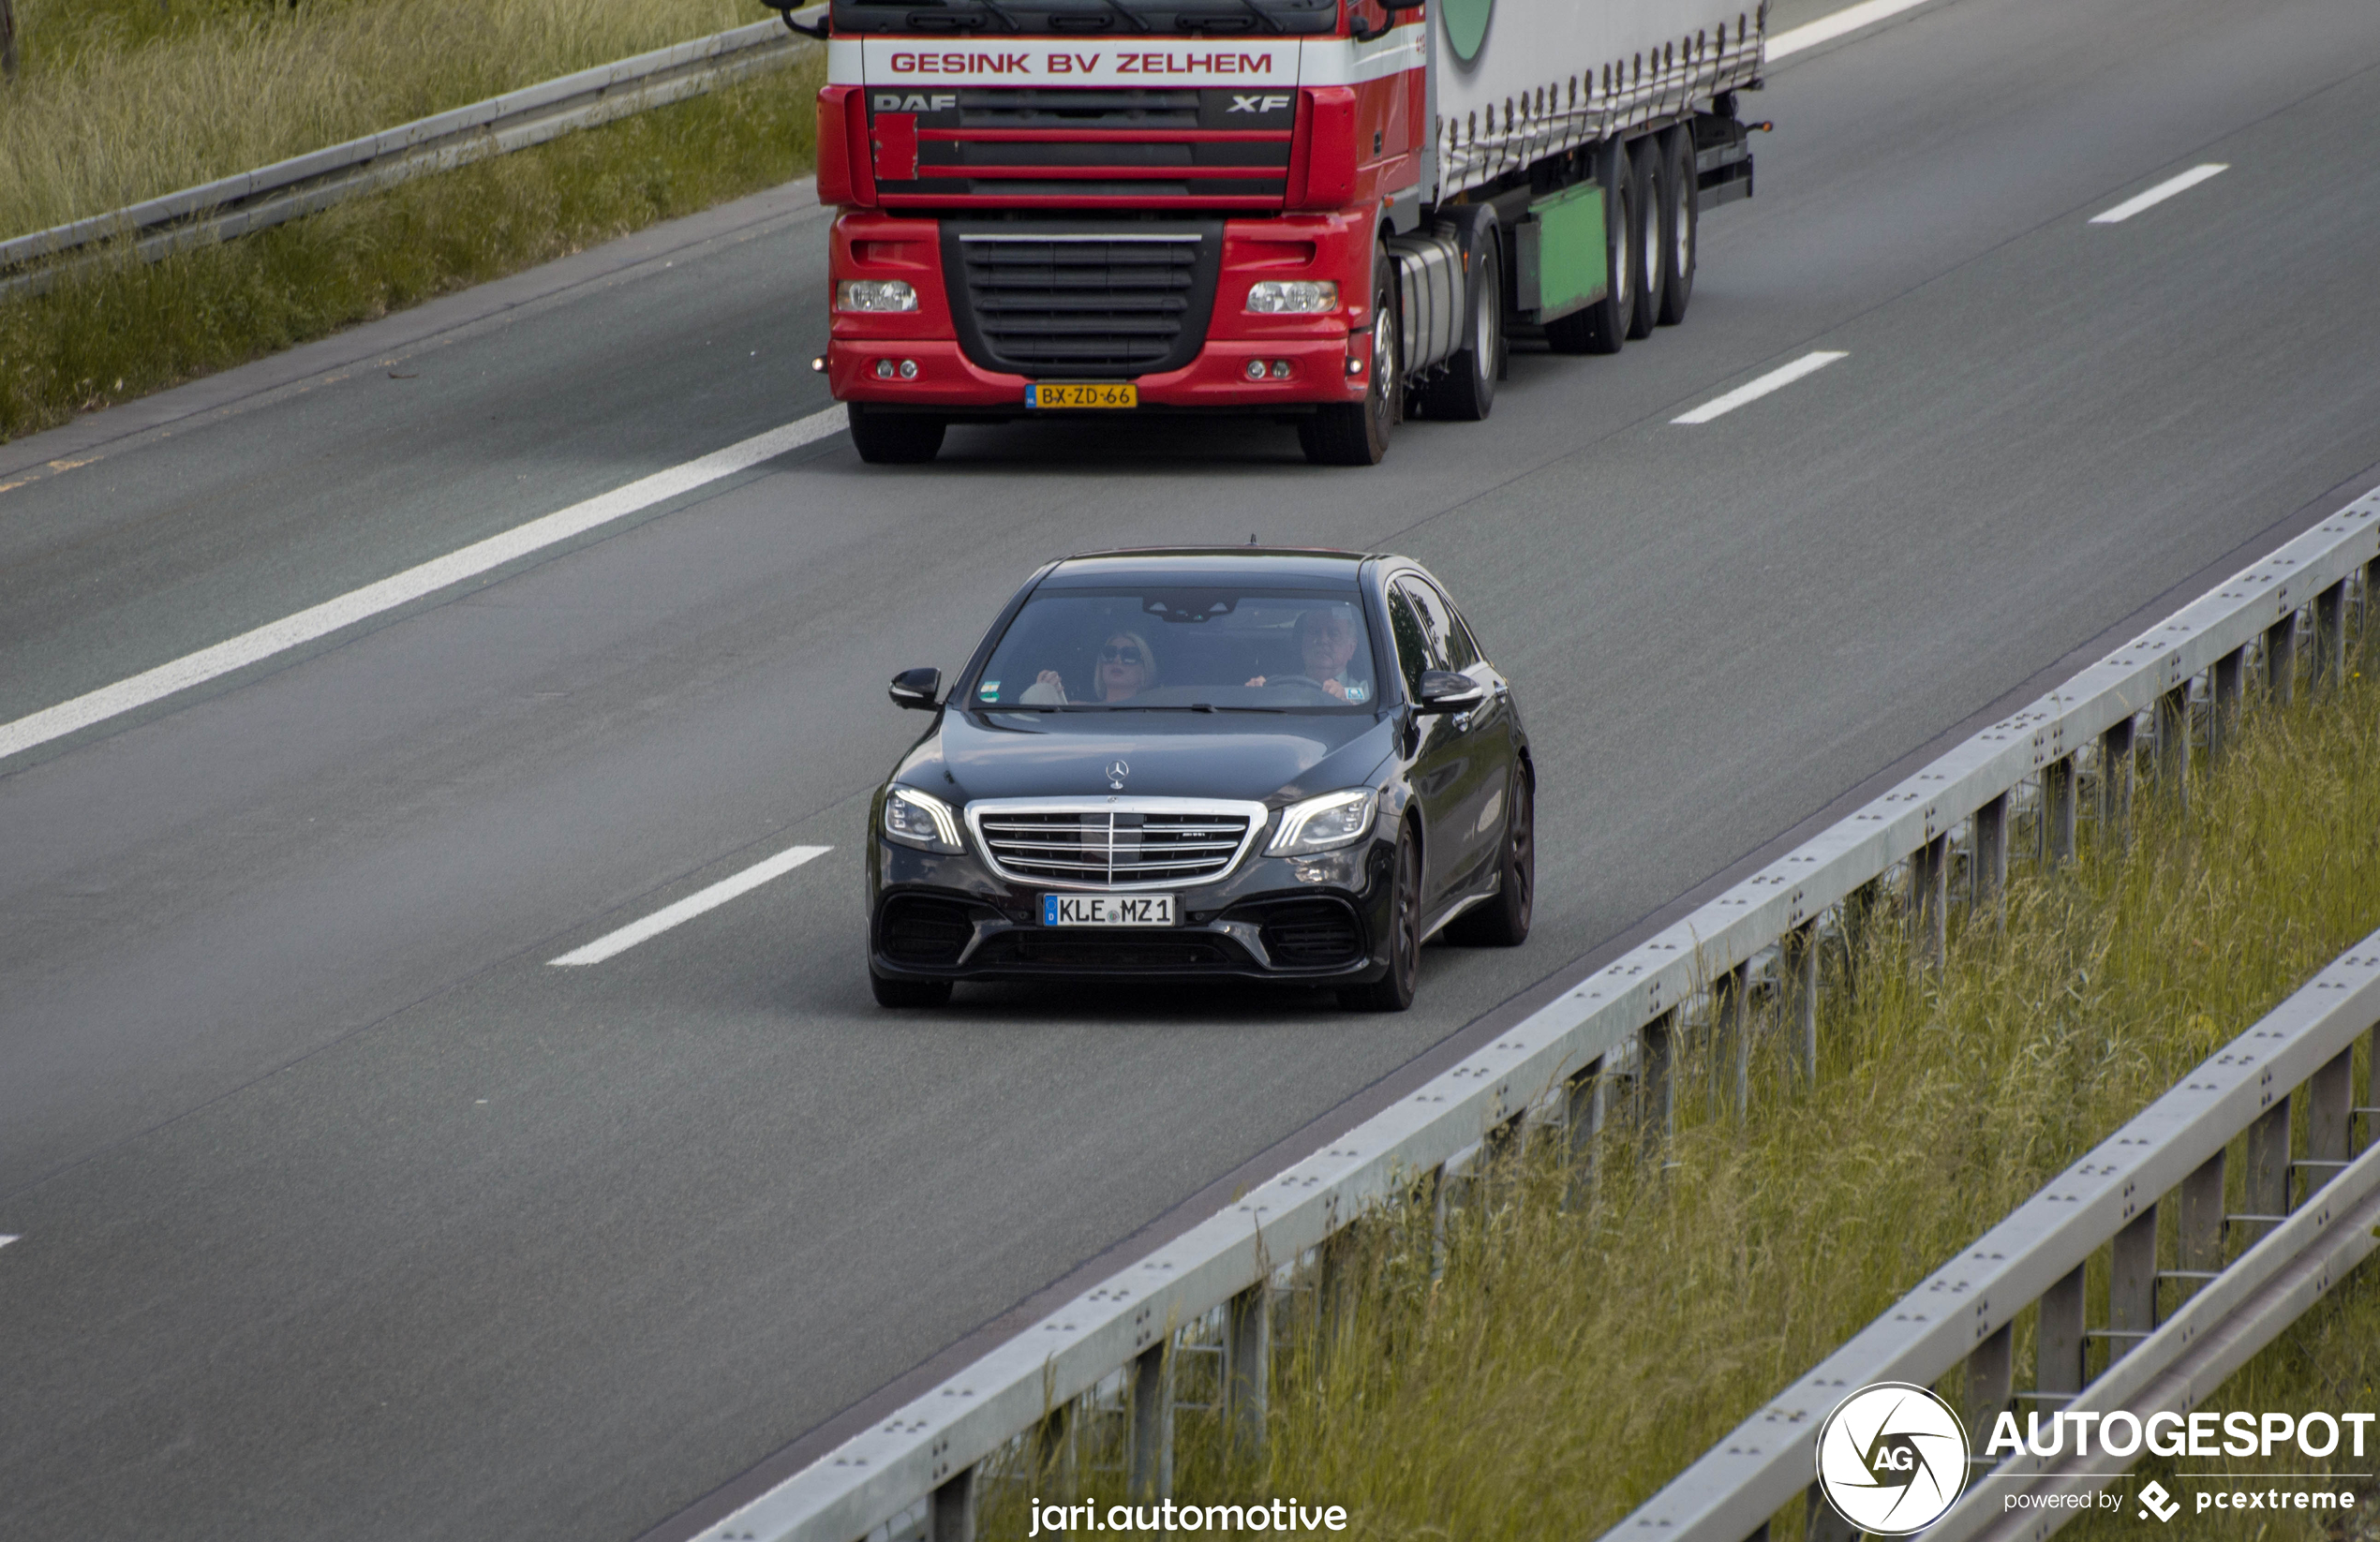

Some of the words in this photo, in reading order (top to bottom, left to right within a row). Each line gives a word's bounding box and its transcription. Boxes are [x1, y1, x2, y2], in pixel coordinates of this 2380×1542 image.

[890, 52, 1031, 74] GESINK
[1047, 53, 1101, 74] BV
[1115, 52, 1272, 74] ZELHEM
[873, 95, 957, 111] DAF
[1225, 95, 1290, 113] XF
[1042, 388, 1130, 405] BX-ZD-66
[1059, 899, 1106, 922] KLE
